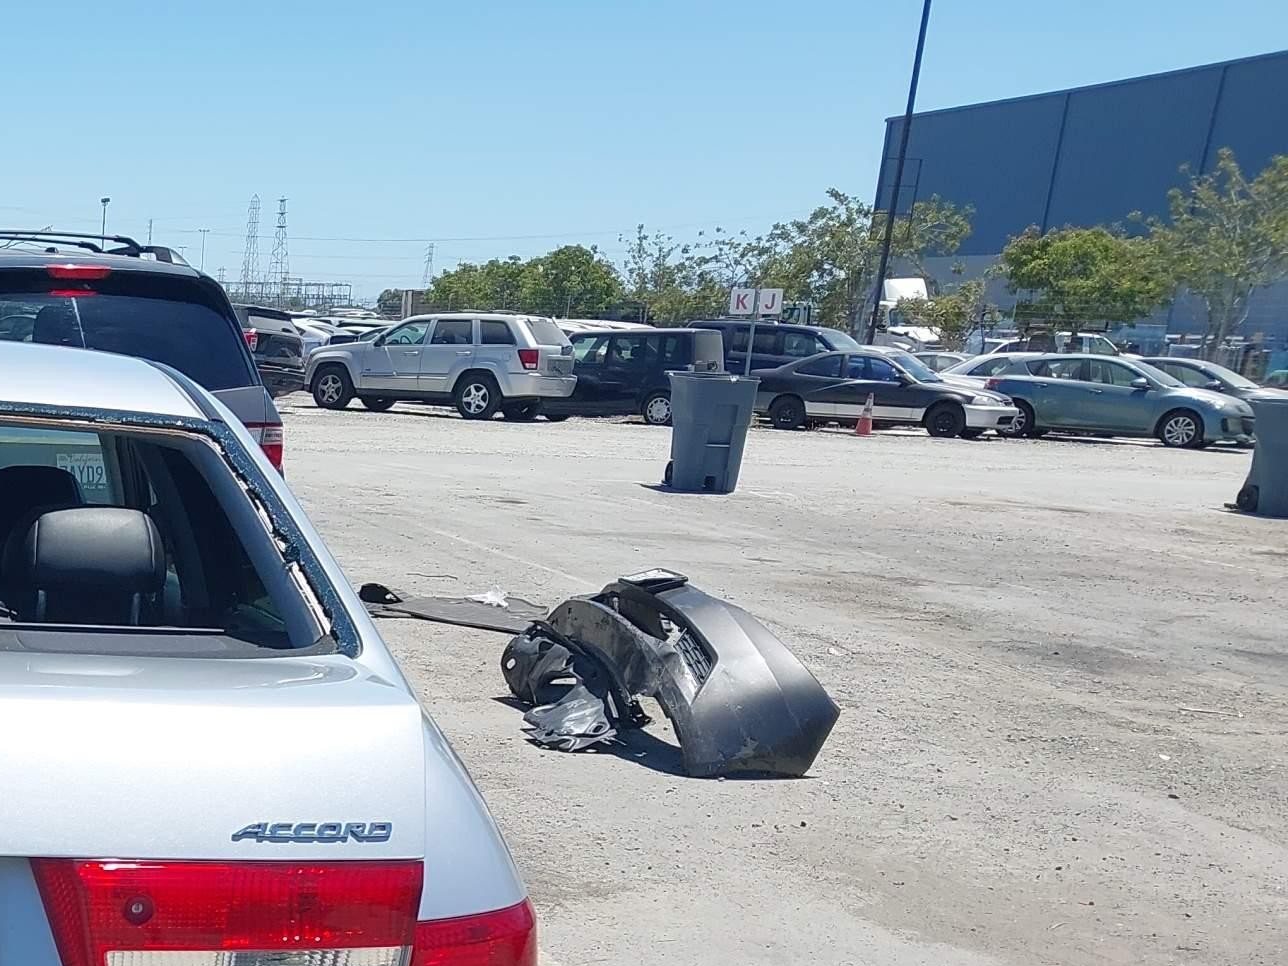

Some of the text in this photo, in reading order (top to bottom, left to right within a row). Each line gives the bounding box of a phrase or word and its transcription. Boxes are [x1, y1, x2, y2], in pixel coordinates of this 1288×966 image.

[735, 293, 749, 310] K
[764, 292, 777, 310] J
[230, 821, 394, 844] ACCORD
